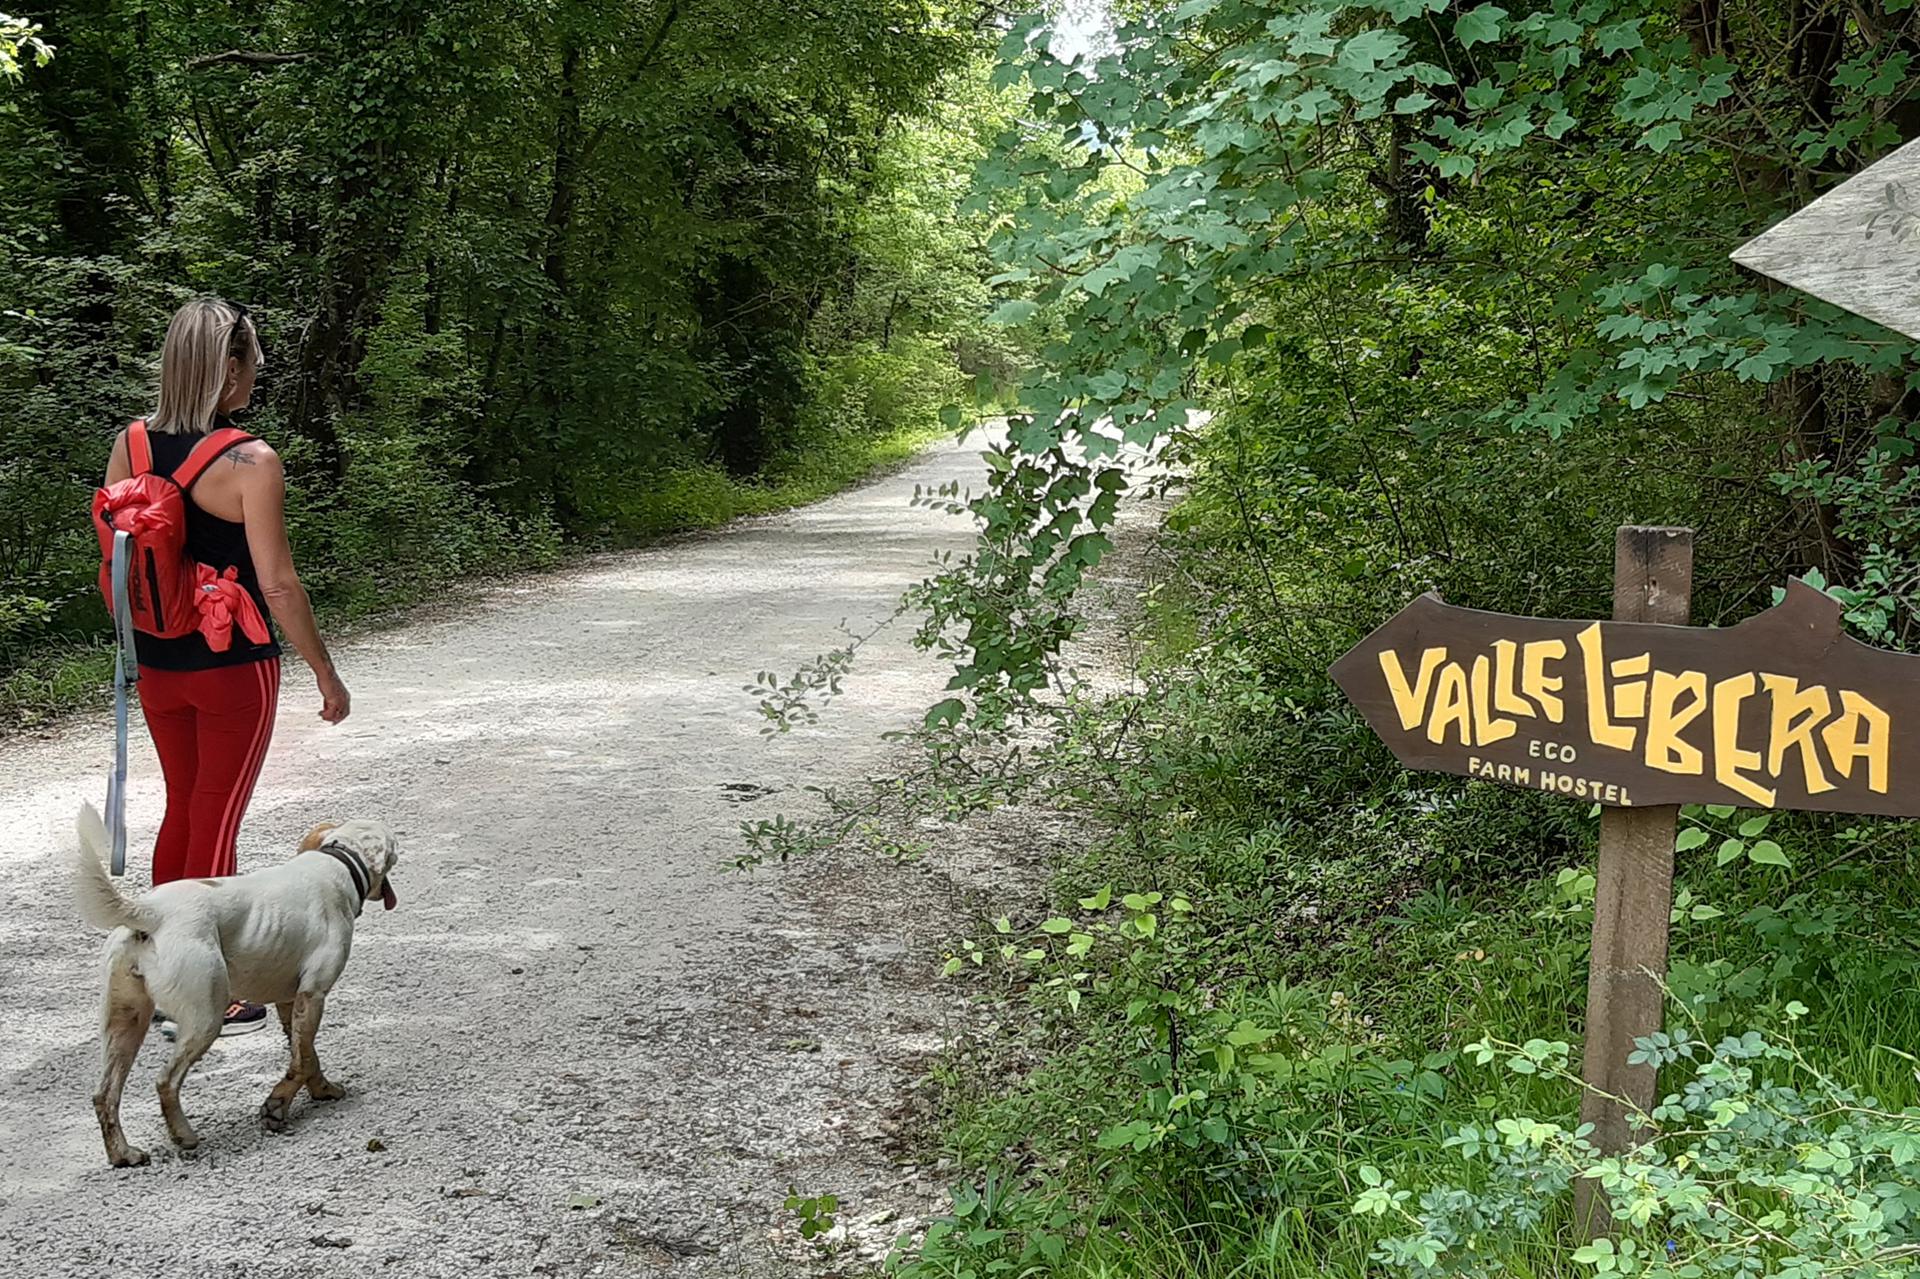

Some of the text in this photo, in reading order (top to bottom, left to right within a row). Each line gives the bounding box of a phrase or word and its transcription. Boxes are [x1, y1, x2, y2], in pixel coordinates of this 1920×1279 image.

[1378, 639, 1566, 746] VALLE
[1528, 740, 1577, 763] ECO
[1468, 757, 1632, 806] FARM HOSTEL
